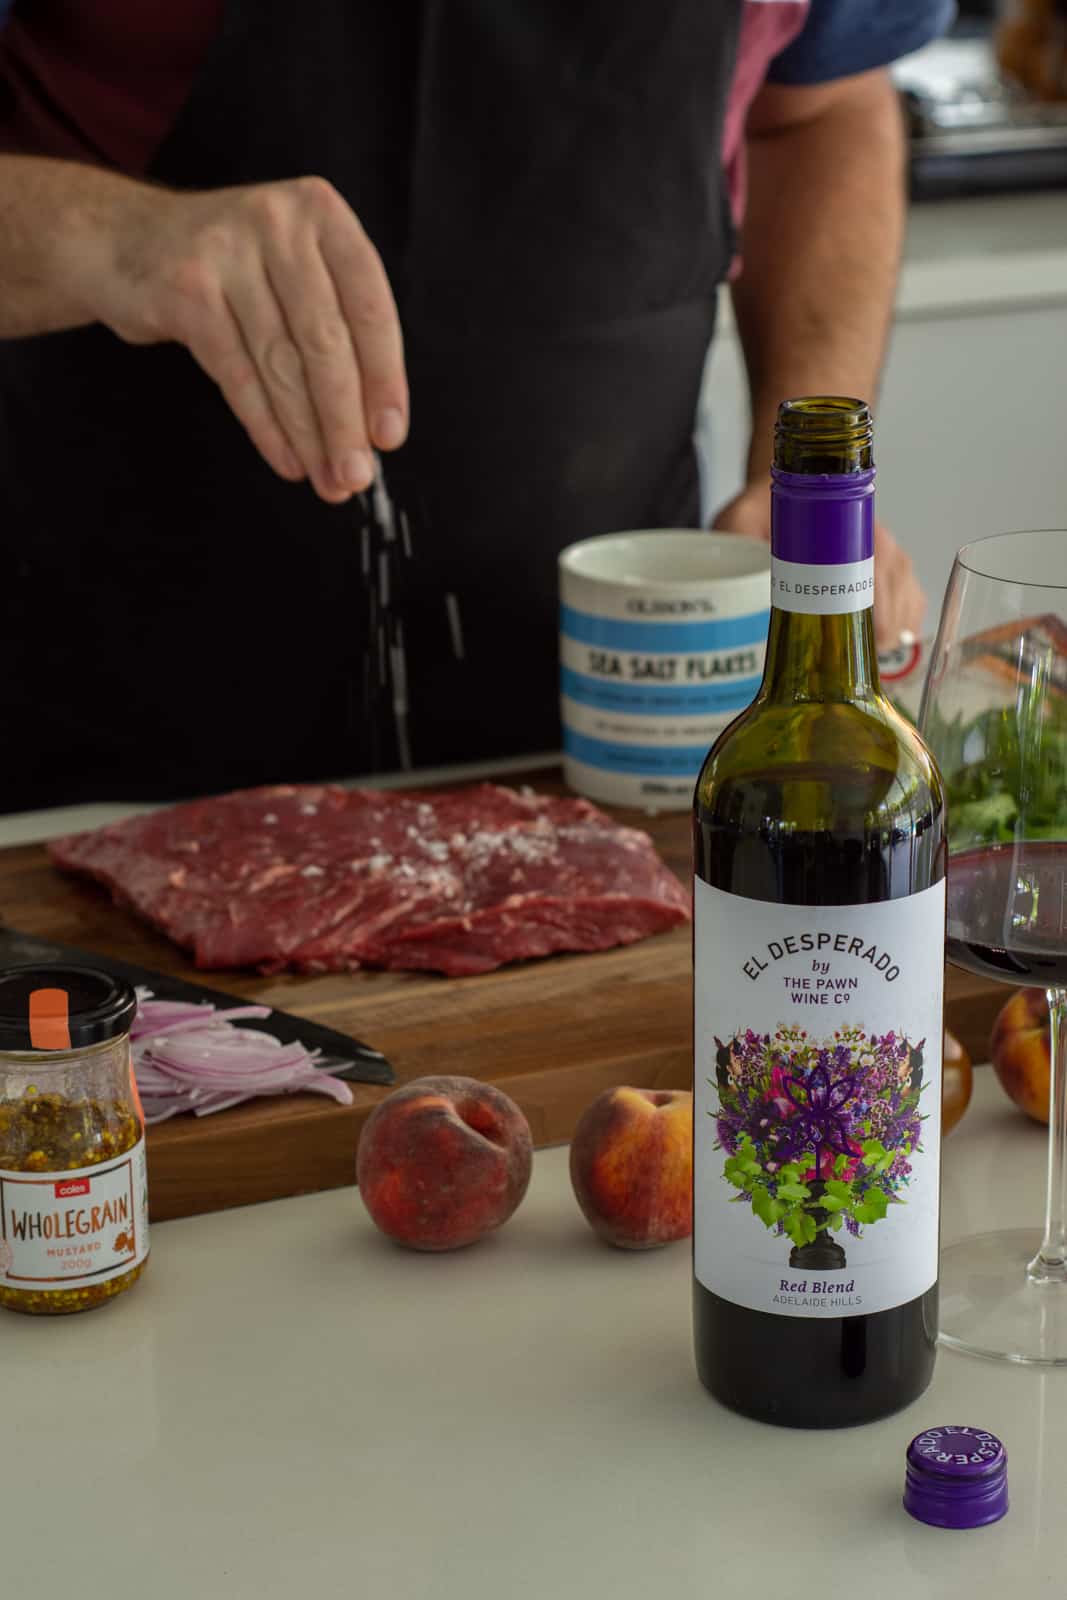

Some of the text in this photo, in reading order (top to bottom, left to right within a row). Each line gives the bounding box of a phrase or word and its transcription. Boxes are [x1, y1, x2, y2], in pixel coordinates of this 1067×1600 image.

[779, 581, 791, 593] EL
[795, 579, 867, 596] DESPERADO
[589, 652, 757, 680] SEA SALT FLAKES
[742, 932, 900, 982] EL DESPERADO
[812, 959, 830, 974] by
[783, 976, 858, 989] THE PAWN
[791, 992, 829, 1004] WINE
[59, 1185, 86, 1196] coles
[11, 1192, 128, 1241] WHOLEGRAIN
[47, 1241, 102, 1257] MUSTARD
[779, 1279, 855, 1294] Red Blend
[772, 1294, 863, 1308] ADELAIDE HILLS
[918, 1430, 1000, 1465] DESPERADO
